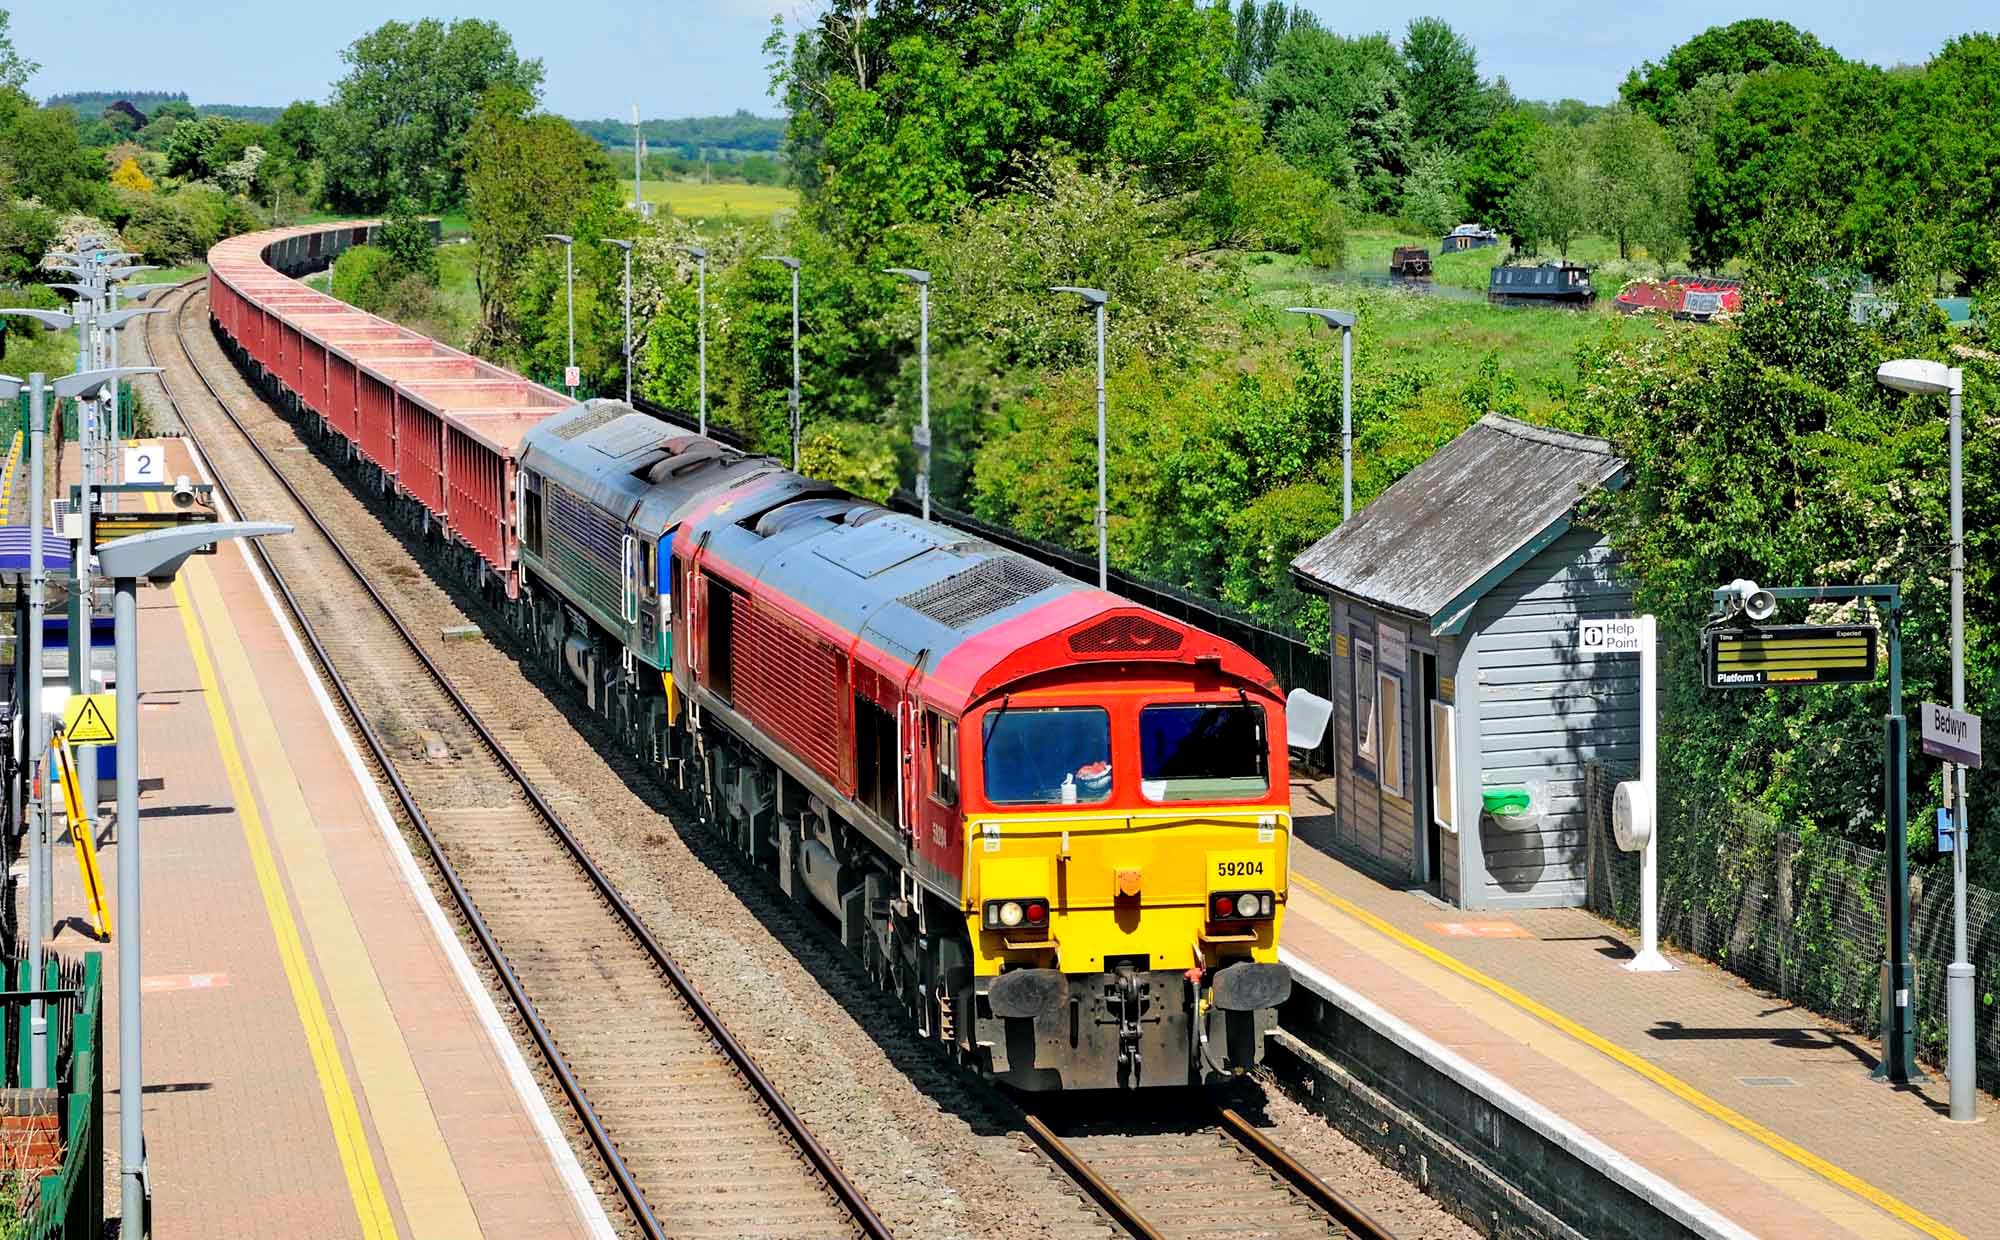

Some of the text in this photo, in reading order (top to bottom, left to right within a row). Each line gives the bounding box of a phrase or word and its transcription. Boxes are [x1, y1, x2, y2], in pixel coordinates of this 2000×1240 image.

[137, 455, 152, 474] 2
[1606, 623, 1635, 636] Help
[1836, 630, 1862, 638] Expected
[1606, 637, 1638, 648] Point
[1717, 672, 1761, 683] Platform 1
[1934, 708, 1968, 743] Bedwyn
[1218, 861, 1264, 877] 59204
